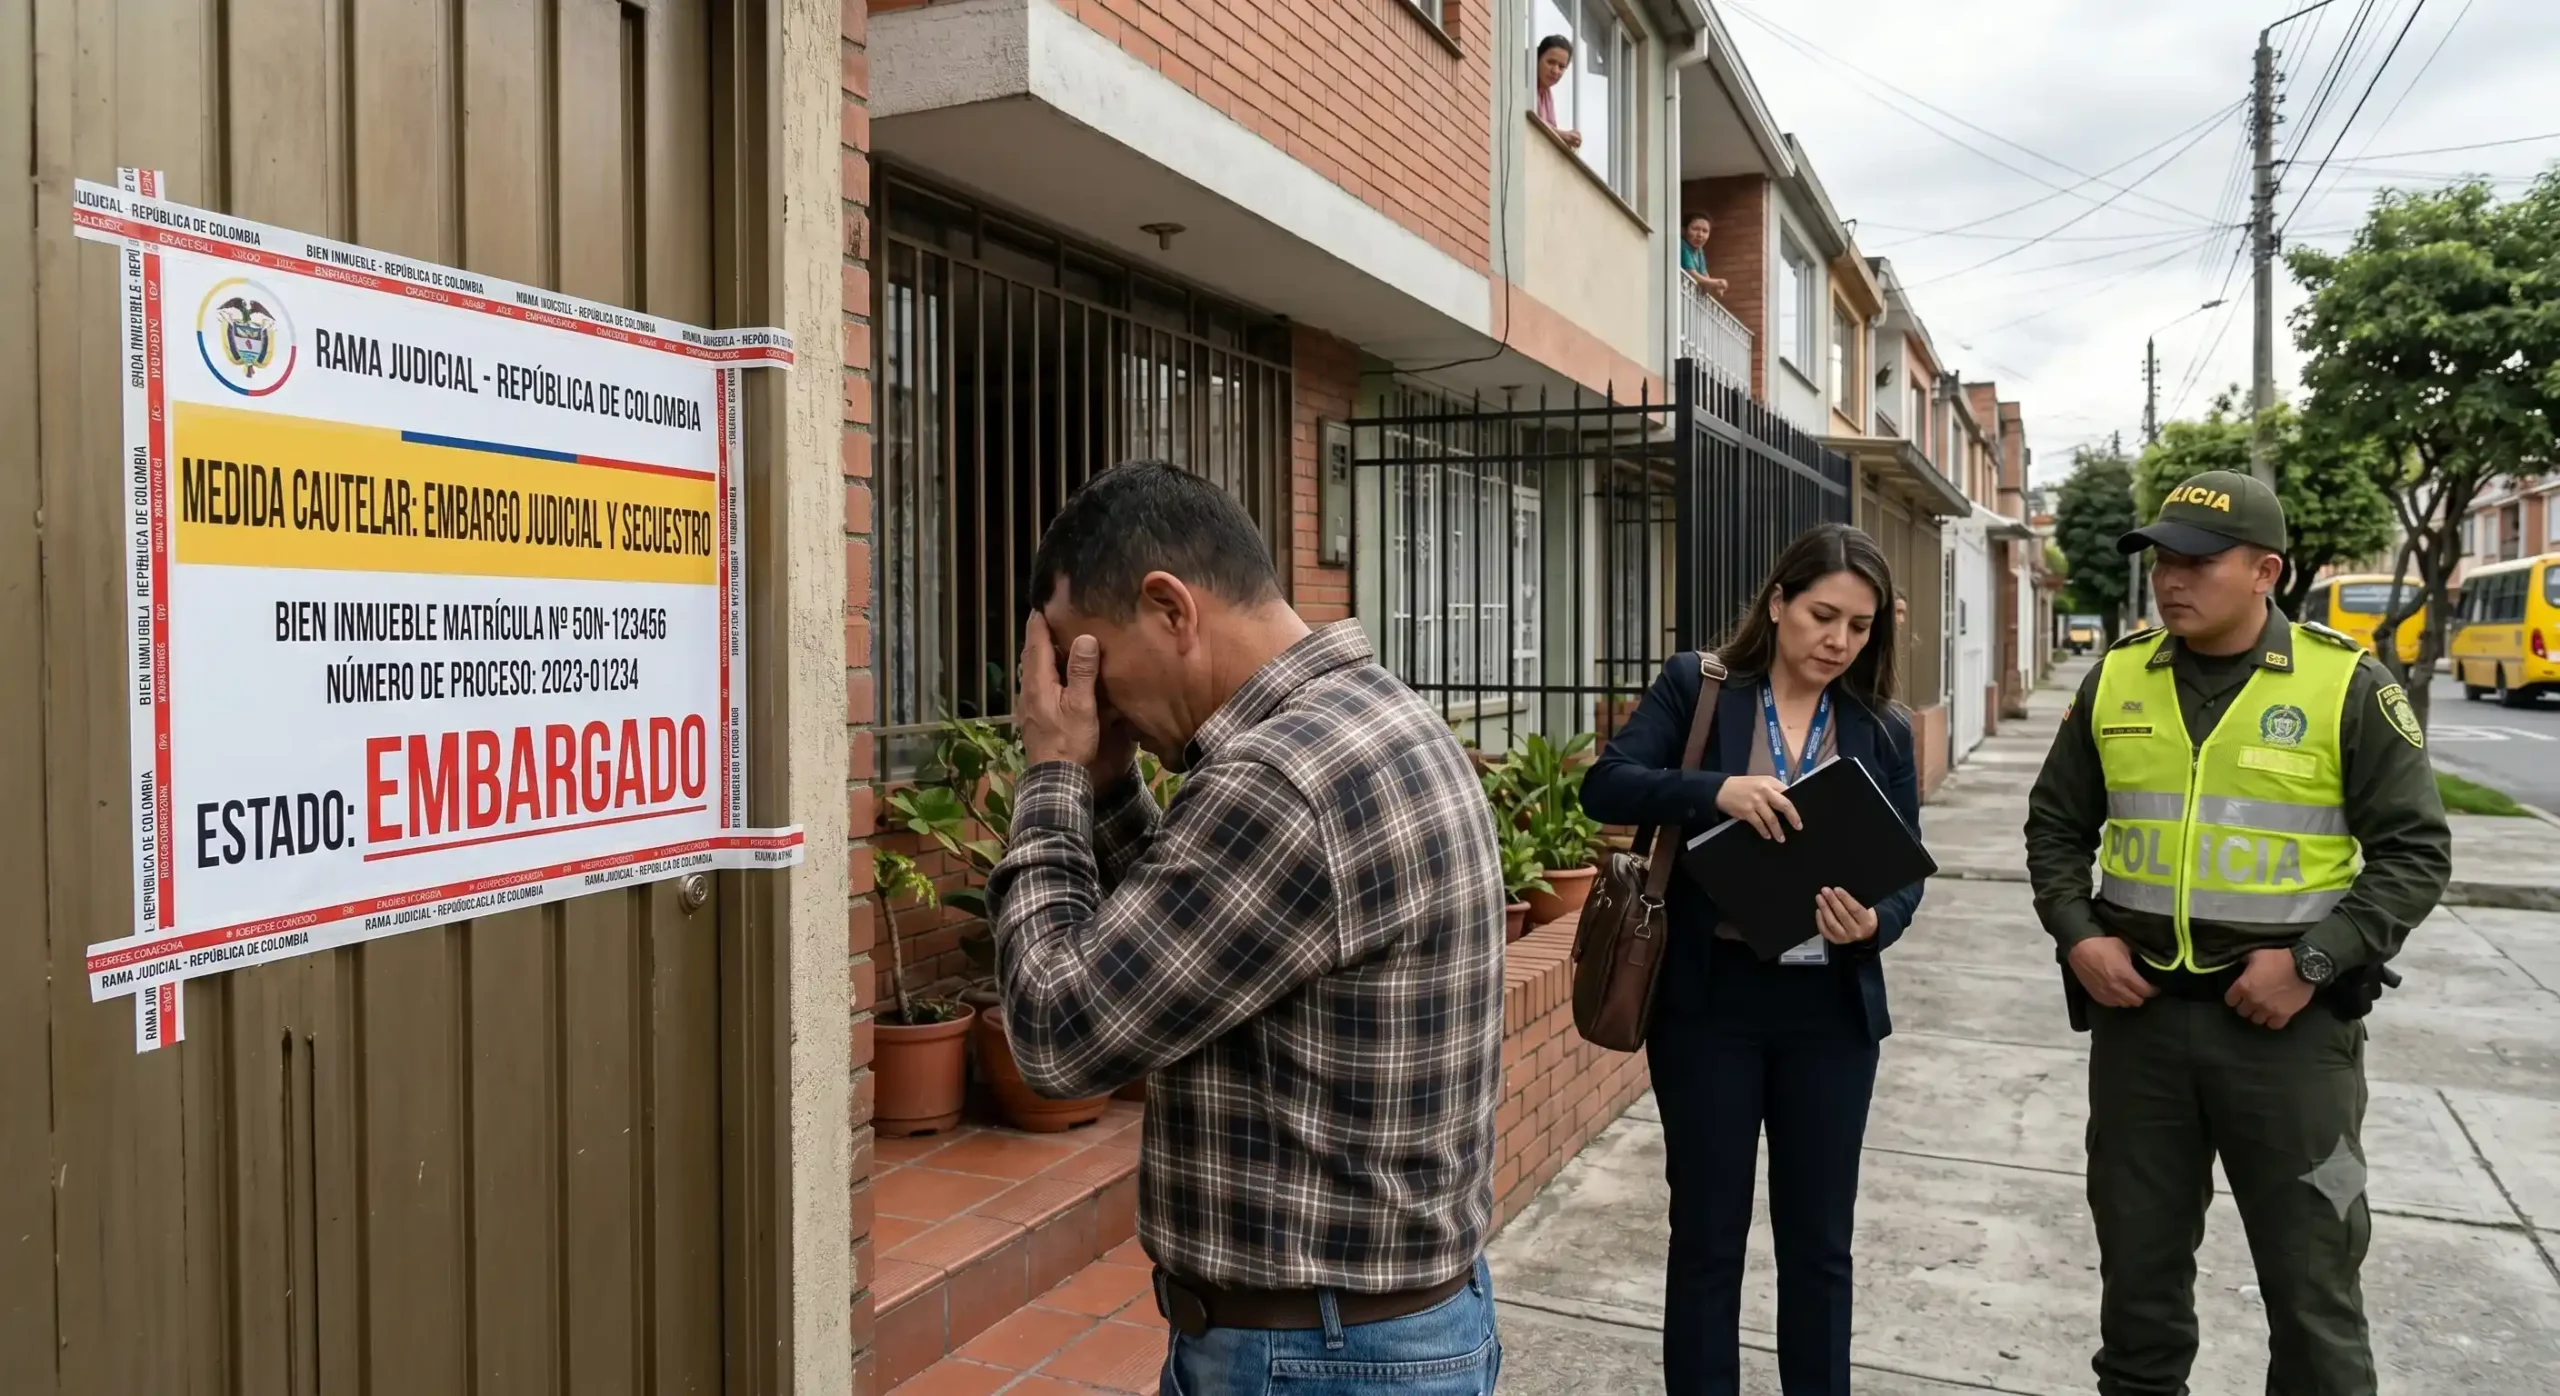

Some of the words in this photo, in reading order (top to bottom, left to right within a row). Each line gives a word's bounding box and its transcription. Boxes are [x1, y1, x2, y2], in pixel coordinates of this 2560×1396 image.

[132, 202, 190, 230] REPÚBLICA
[193, 219, 206, 233] DE
[209, 222, 261, 246] COLOMBIA
[306, 244, 329, 261] BIEN
[385, 261, 430, 283] REPÚBLICA
[432, 272, 443, 286] DE
[445, 276, 484, 295] COLOMBIA
[615, 315, 624, 328] DE
[315, 327, 383, 378] RAMA
[389, 343, 478, 394] JUDICIAL
[497, 364, 594, 414] REPÚBLICA
[600, 383, 620, 417] DE
[625, 389, 701, 432] COLOMBIA
[134, 446, 147, 506] COLOMBIA
[135, 509, 148, 525] DE
[182, 457, 286, 528] MEDIDA
[292, 468, 418, 536] CAUTELAR:
[424, 482, 520, 543] EMBARGO
[526, 492, 602, 549] JUDICIAL
[606, 501, 618, 550] Y
[622, 502, 711, 557] SECUESTRO
[276, 601, 326, 642] BIEN
[334, 602, 437, 642] INMUEBLE
[443, 597, 544, 641] MATRÍCULA
[573, 606, 666, 640] 50N-123456
[139, 674, 151, 706] BIEN
[327, 655, 413, 704] NÚMERO
[421, 662, 445, 700] DE
[451, 659, 536, 698] PROCESO:
[542, 658, 639, 694] 2023-01234
[142, 770, 154, 832] COLOMBIA
[366, 713, 707, 844] EMBARGADO
[143, 837, 154, 851] DE
[197, 789, 356, 869] ESTADO:
[585, 872, 605, 886] RAMA
[673, 858, 681, 870] DE
[2111, 826, 2305, 886] POLICIA
[365, 914, 391, 931] RAMA
[393, 906, 431, 926] JUDICIAL
[497, 892, 506, 905] DE
[507, 885, 544, 903] COLOMBIA
[102, 968, 134, 989] RAMA
[136, 959, 182, 981] JUDICIAL
[247, 941, 260, 956] DE
[261, 932, 309, 953] COLOMBIA
[145, 1007, 157, 1040] RAMA
